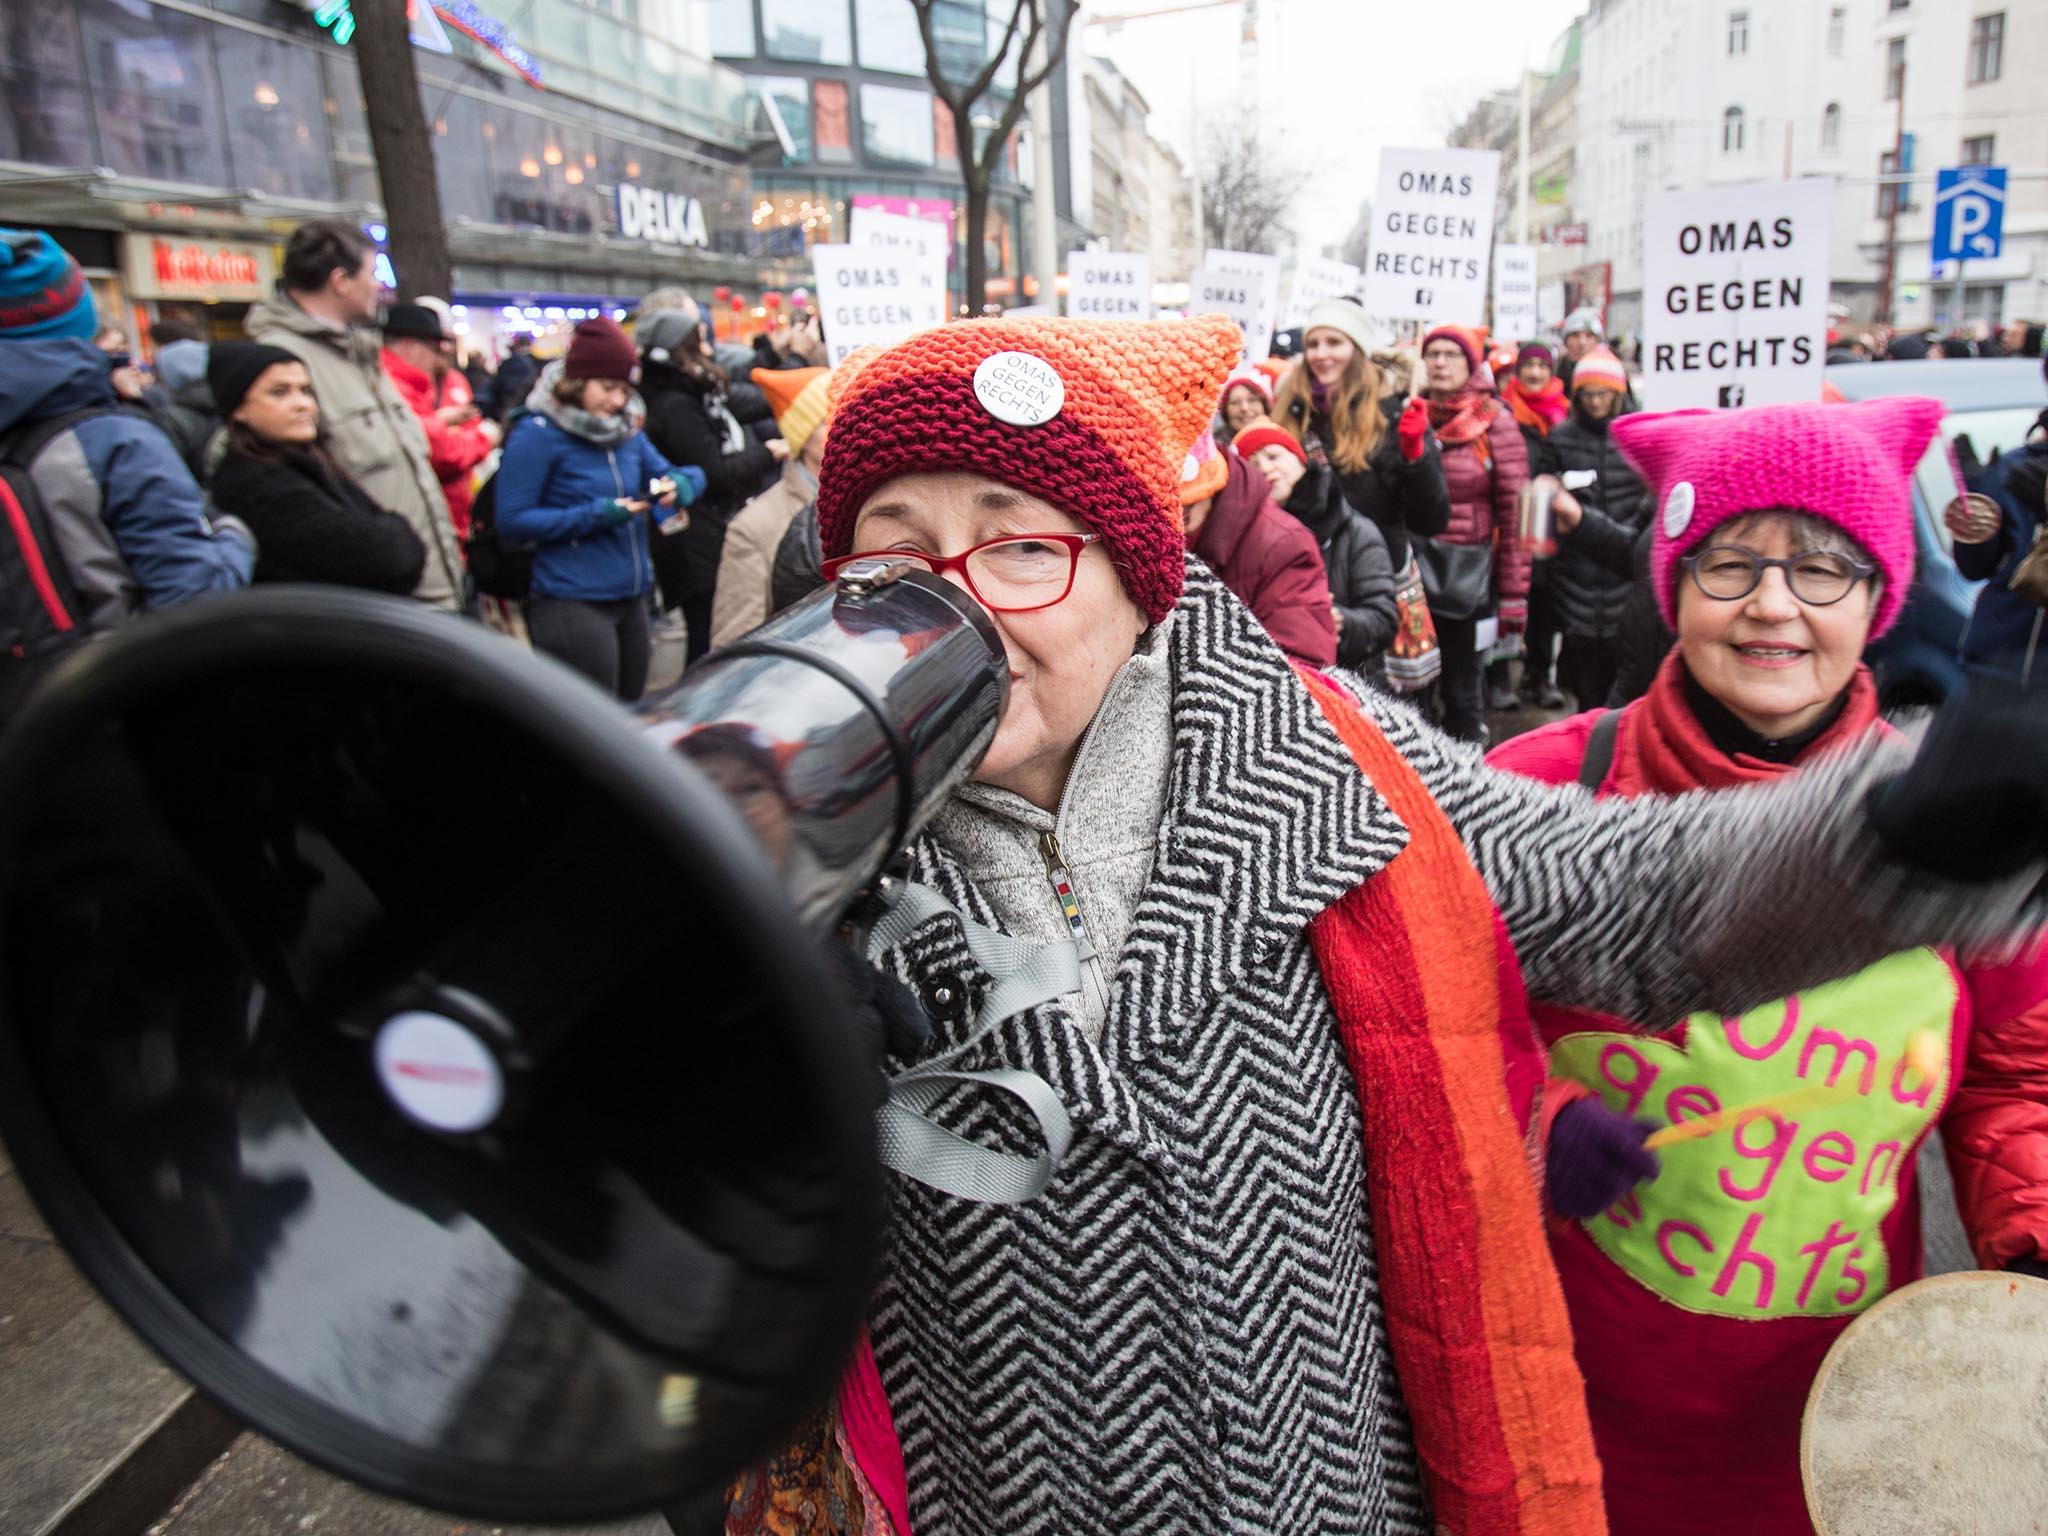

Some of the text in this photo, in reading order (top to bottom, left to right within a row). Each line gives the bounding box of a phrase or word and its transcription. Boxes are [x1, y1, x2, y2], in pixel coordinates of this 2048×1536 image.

[1399, 171, 1473, 196] OMAS
[619, 183, 708, 247] DELKA
[1387, 212, 1476, 238] GEGEN
[1949, 195, 1991, 253] P
[1679, 218, 1792, 255] OMAS
[837, 269, 900, 287] OMAS
[1085, 270, 1135, 284] OMAS
[1375, 253, 1478, 280] RECHTS
[1079, 297, 1139, 312] GEGEN
[1203, 287, 1247, 304] OMAS
[1667, 278, 1801, 314] GEGEN
[836, 306, 912, 326] GEGEN
[1655, 336, 1811, 372] RECHTS
[992, 367, 1051, 405] GEGEN
[1007, 355, 1057, 388] OMAS
[977, 379, 1043, 422] RECHTS
[1721, 994, 1943, 1108] Oma
